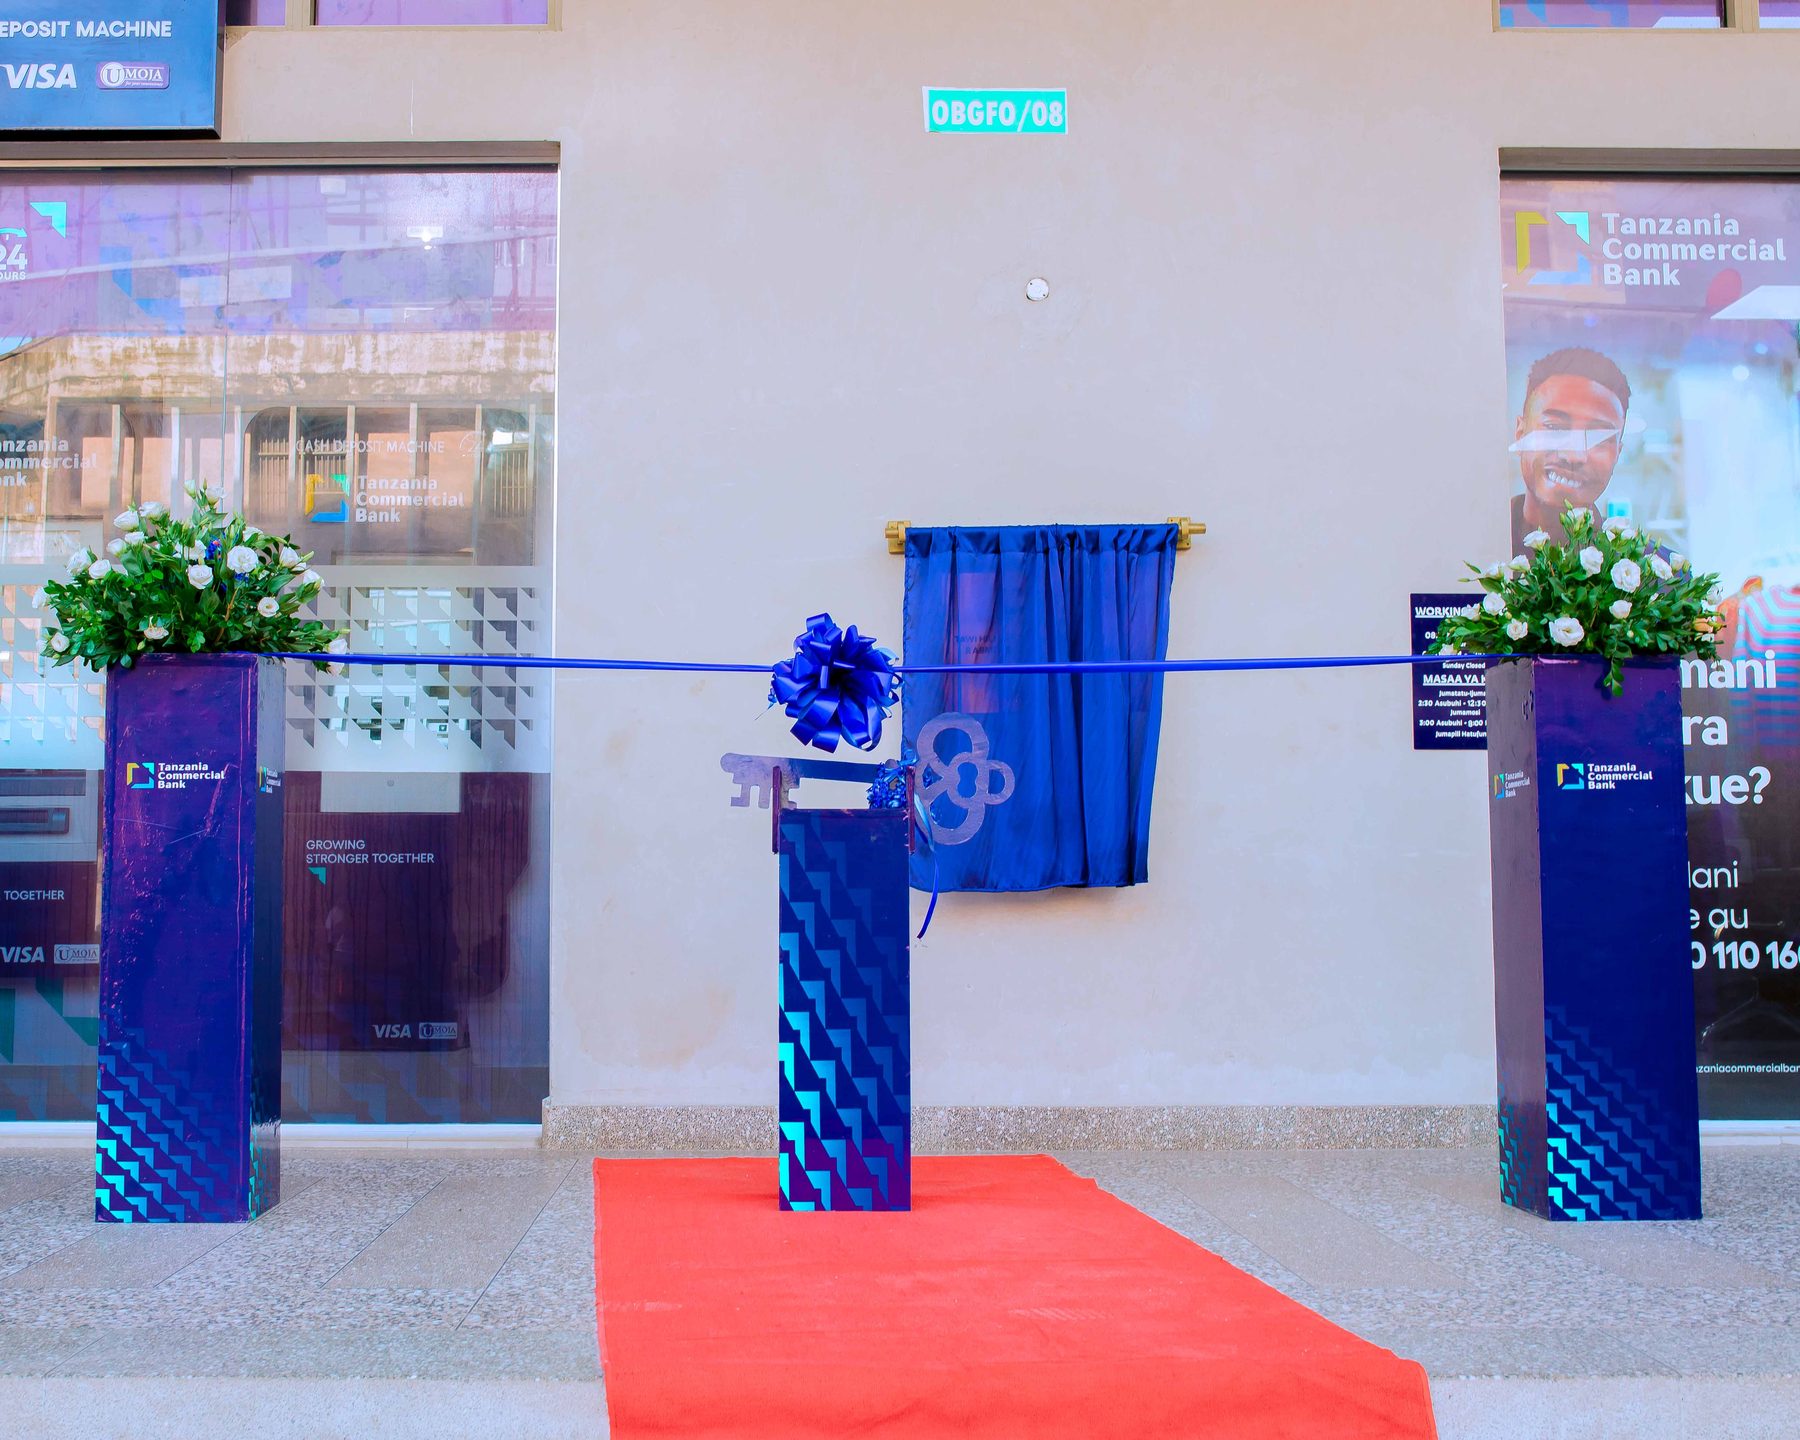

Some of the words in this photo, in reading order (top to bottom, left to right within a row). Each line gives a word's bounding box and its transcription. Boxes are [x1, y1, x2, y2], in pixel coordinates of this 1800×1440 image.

[77, 21, 172, 37] MACHINE
[0, 63, 77, 89] VISA
[104, 67, 163, 84] UMOJA
[931, 100, 1063, 132] OBGFO/08
[1602, 212, 1739, 236] Tanzania
[1602, 238, 1786, 261] Commercial
[1603, 263, 1681, 285] Bank
[0, 436, 69, 452] nzania
[296, 440, 329, 453] CASH
[333, 440, 384, 453] DEPOSIT
[387, 440, 445, 453] MACHINE
[0, 471, 27, 487] nk
[357, 475, 438, 490] Tanzania
[356, 492, 464, 507] Commercial
[355, 509, 401, 523] Bank
[1415, 607, 1465, 616] WORKIN
[1442, 662, 1464, 670] Sunday
[1423, 674, 1462, 684] MASAA
[1464, 674, 1479, 684] YA
[1436, 719, 1462, 727] Asubuhi
[1435, 731, 1461, 739] Jumapili
[158, 762, 208, 771] Tanzania
[1588, 763, 1636, 772] Tanzania
[158, 770, 225, 780] Commercial
[1588, 771, 1653, 781] Commercial
[157, 780, 186, 789] Bank
[1588, 781, 1615, 790] Bank
[306, 840, 366, 850] GROWING
[306, 853, 369, 864] STRONGER
[372, 853, 435, 864] TOGETHER
[3, 890, 65, 900] TOGETHER
[0, 946, 45, 963] VISA
[1712, 941, 1760, 970] 110
[1765, 941, 1800, 970] 16
[372, 1024, 412, 1038] VISA
